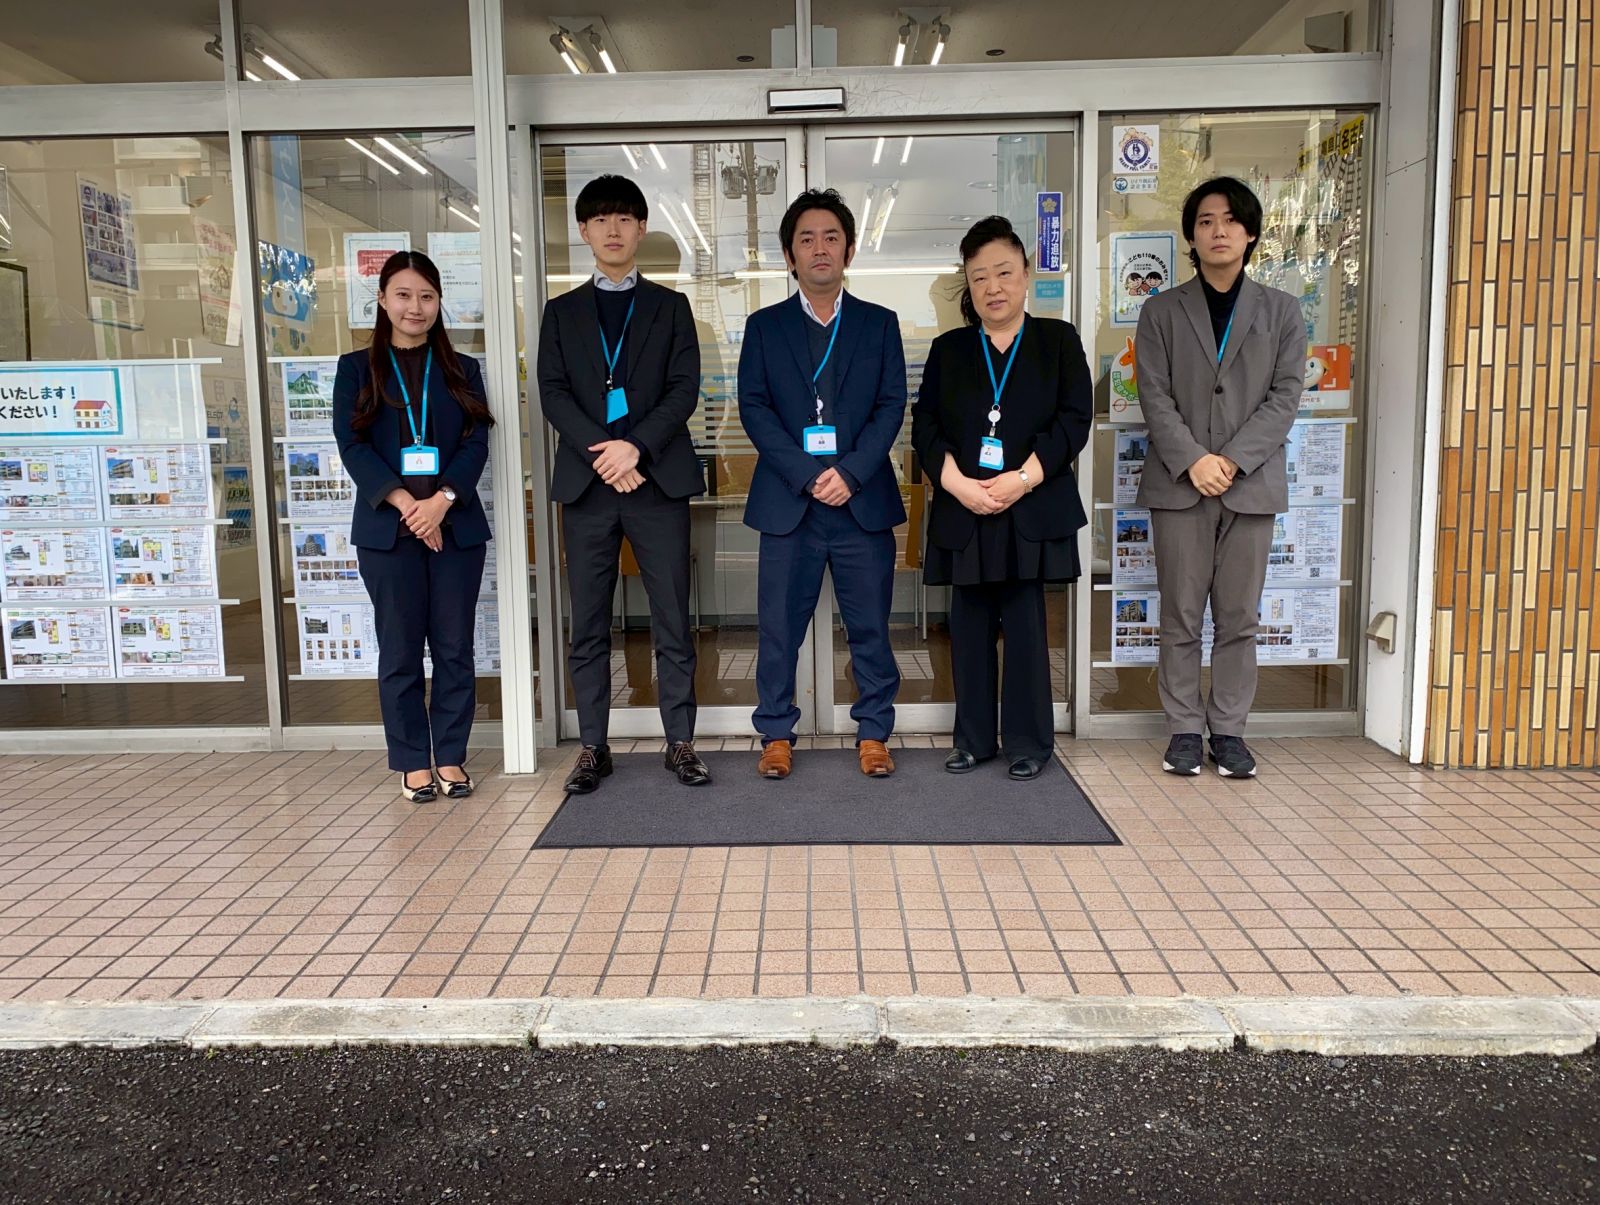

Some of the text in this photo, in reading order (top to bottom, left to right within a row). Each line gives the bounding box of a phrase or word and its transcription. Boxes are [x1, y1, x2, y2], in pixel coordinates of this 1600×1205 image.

[1050, 216, 1060, 268] 暴力追放
[1, 386, 77, 400] いたします！
